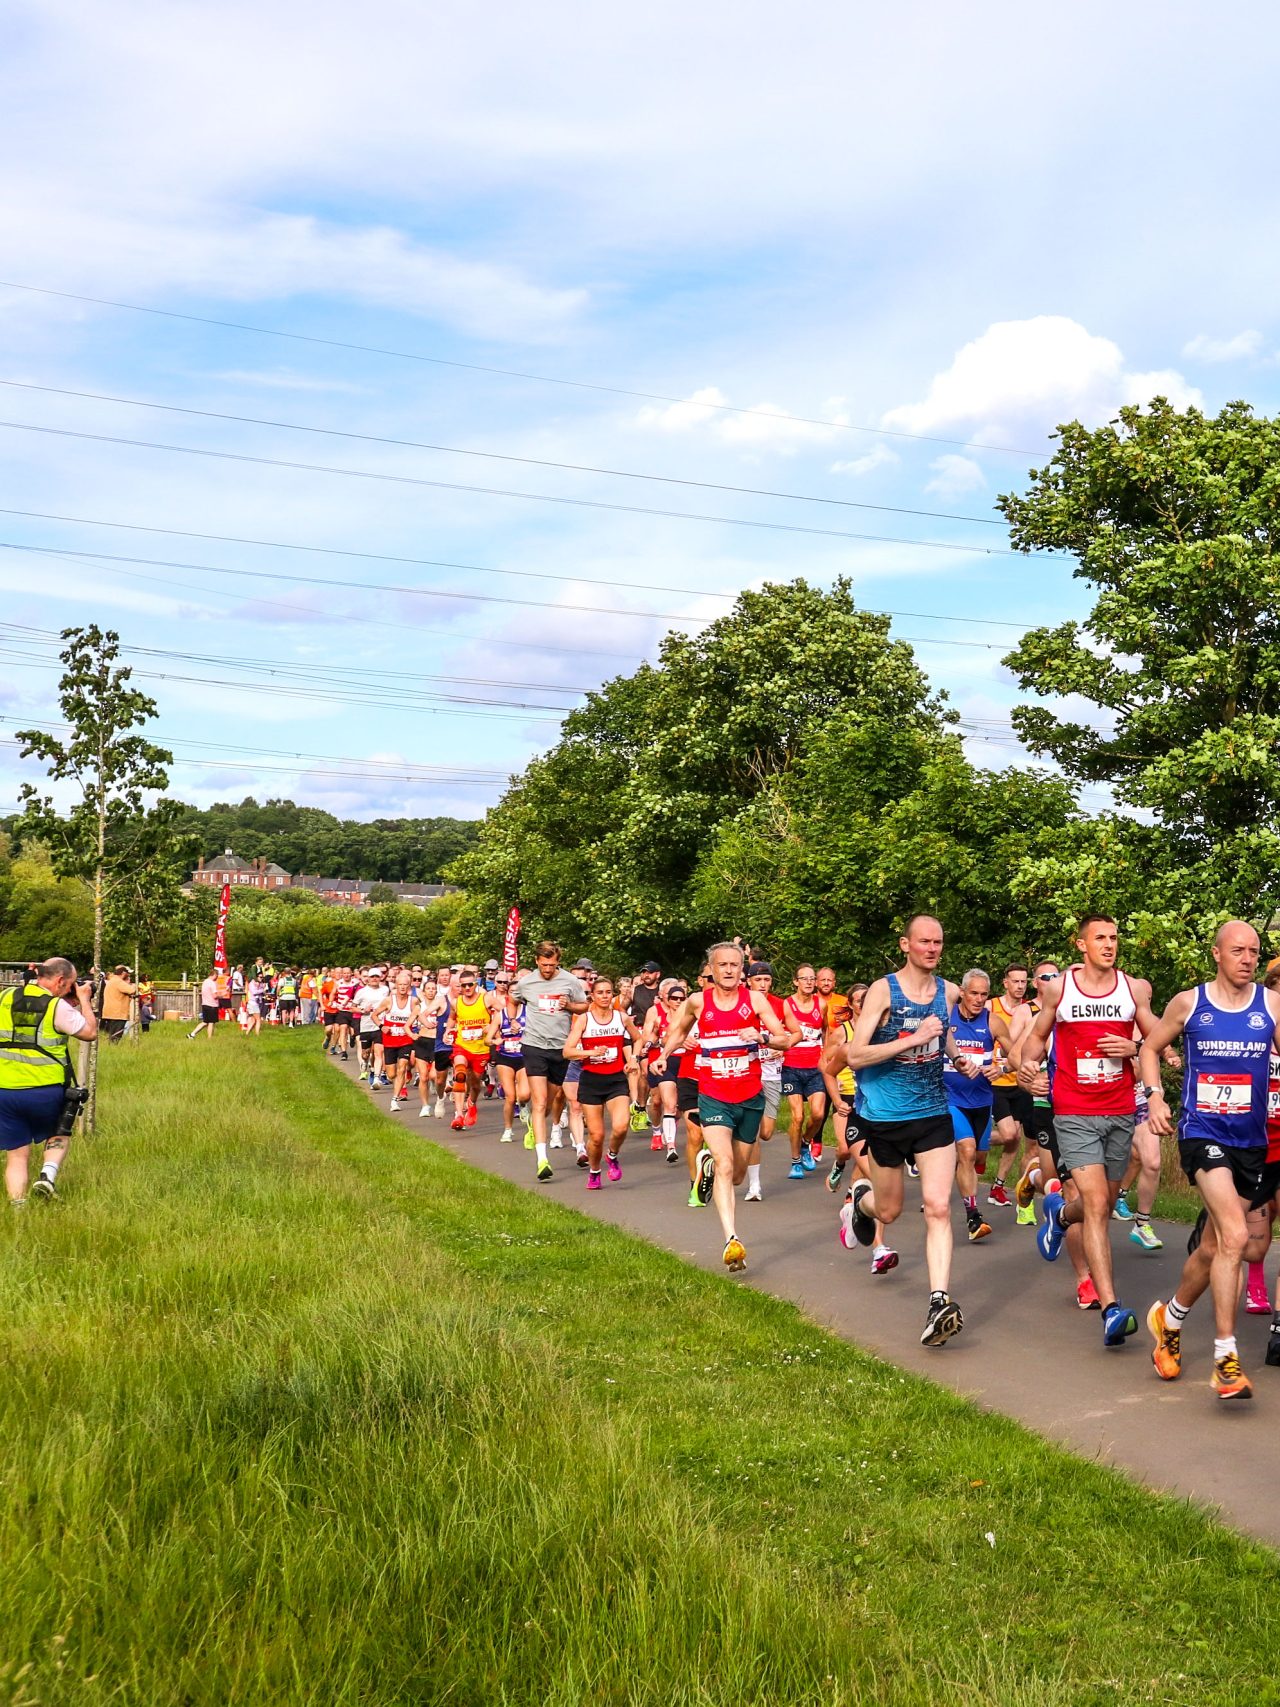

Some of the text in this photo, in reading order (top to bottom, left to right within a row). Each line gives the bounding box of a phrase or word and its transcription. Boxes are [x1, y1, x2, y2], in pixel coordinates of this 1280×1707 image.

[214, 900, 227, 962] START
[504, 917, 515, 970] INISH
[1071, 1004, 1122, 1018] ELSWICK
[590, 1027, 619, 1037] ELSWICK
[955, 1039, 984, 1048] ORPETH
[1197, 1040, 1267, 1052] SUNDERLAND
[723, 1058, 739, 1069] 137
[1097, 1059, 1105, 1071] 4
[1216, 1085, 1232, 1100] 79
